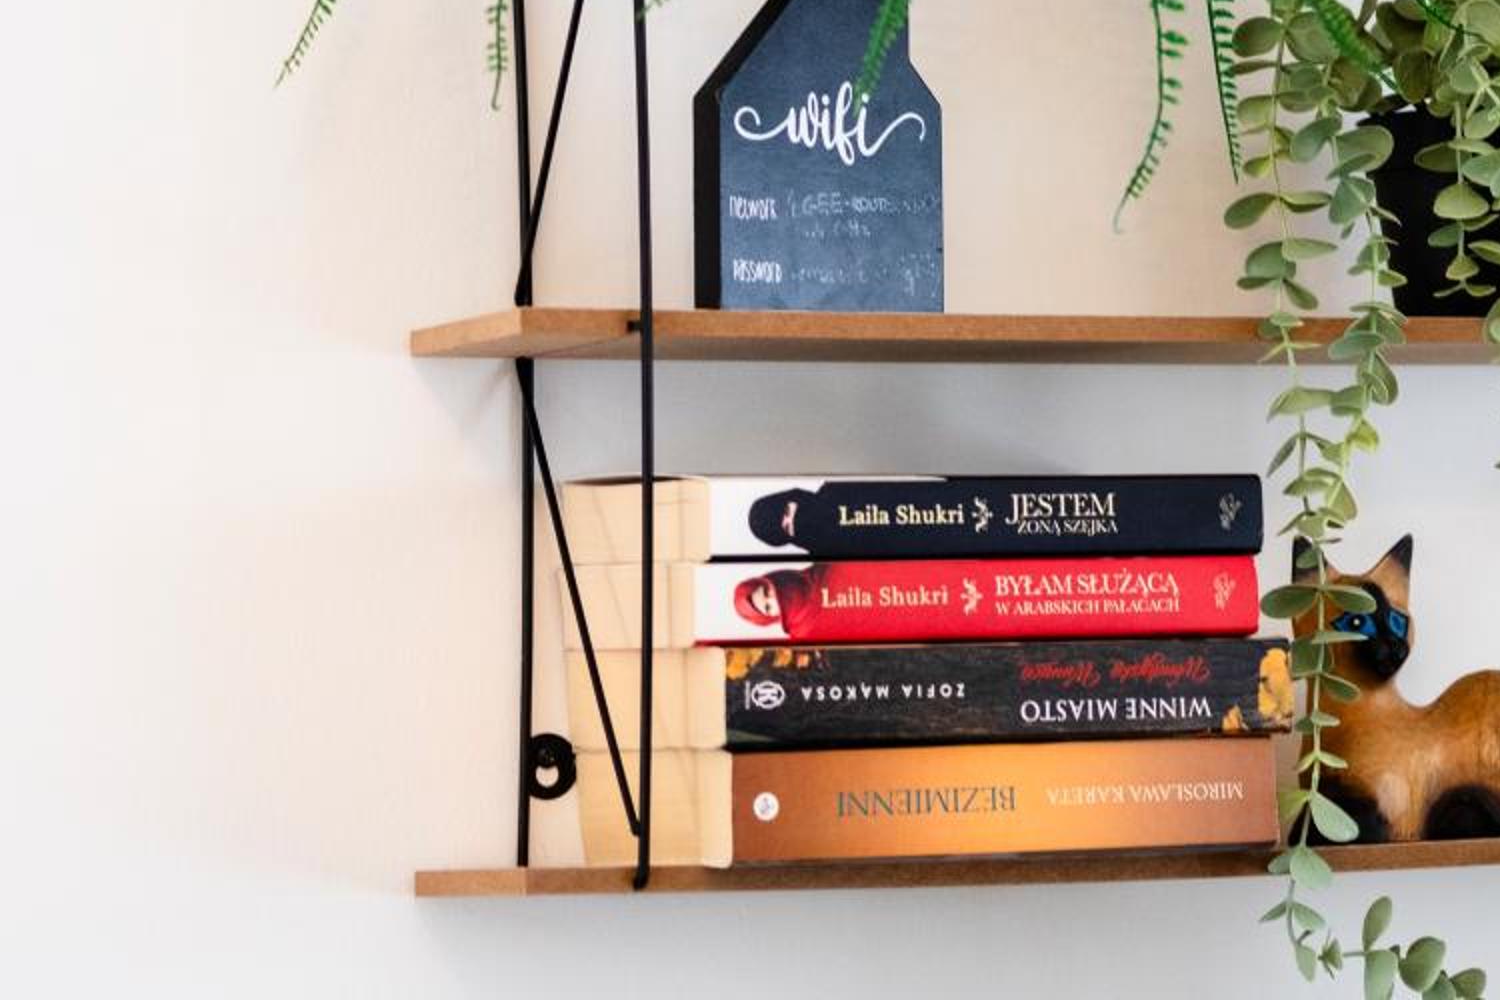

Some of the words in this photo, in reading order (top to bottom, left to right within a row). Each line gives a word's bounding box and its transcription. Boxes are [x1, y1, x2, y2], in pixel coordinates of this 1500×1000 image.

[733, 80, 927, 166] wifi
[839, 505, 889, 526] Laila
[895, 503, 965, 525] Shukri
[1005, 493, 1117, 526] JESTEM
[1063, 519, 1119, 537] SZEJKA
[995, 574, 1072, 597] BYŁAM
[1077, 568, 1180, 597] SŁUŻĄCĄ
[821, 587, 873, 608] Laila
[879, 585, 948, 606] Shukri
[995, 601, 1010, 616] W
[1015, 599, 1100, 616] ARABSKICH
[801, 681, 889, 700] MĄKOSA
[901, 683, 965, 698] ZOFIA
[1020, 698, 1118, 722] MIASTO
[1125, 697, 1212, 719] WINNE
[836, 785, 1017, 818] BEZIMIENNI
[1044, 784, 1120, 806] KARETA
